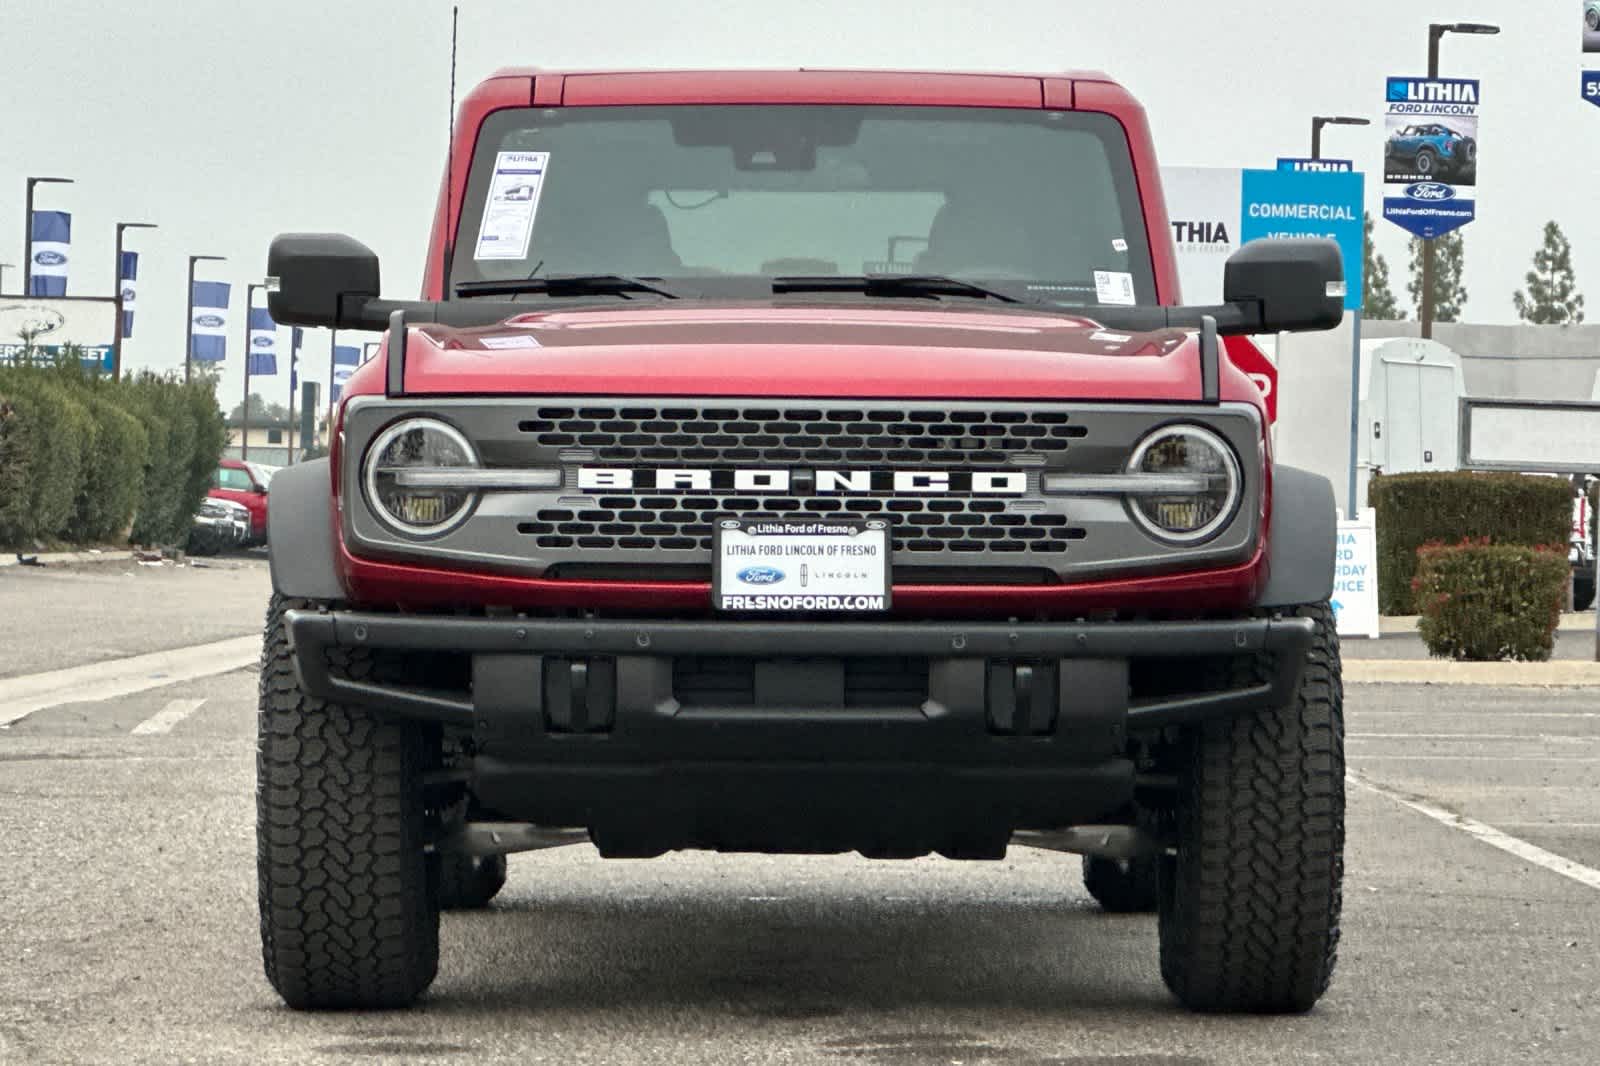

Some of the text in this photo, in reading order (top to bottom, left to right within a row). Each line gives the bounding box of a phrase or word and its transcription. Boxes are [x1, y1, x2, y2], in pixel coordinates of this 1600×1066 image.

[1408, 83, 1475, 102] LITHIA
[1586, 82, 1600, 96] 5
[1389, 104, 1475, 114] FORD LINCOLN
[1249, 203, 1356, 220] COMMERCIAL
[1172, 221, 1230, 243] THIA
[578, 468, 1027, 493] BRONCO
[757, 523, 848, 533] Lithia Ford of Fresno
[727, 545, 877, 556] LITHIA FORD LINCOLN OF FRESNO
[722, 596, 884, 609] FRESNOFORD.COM
